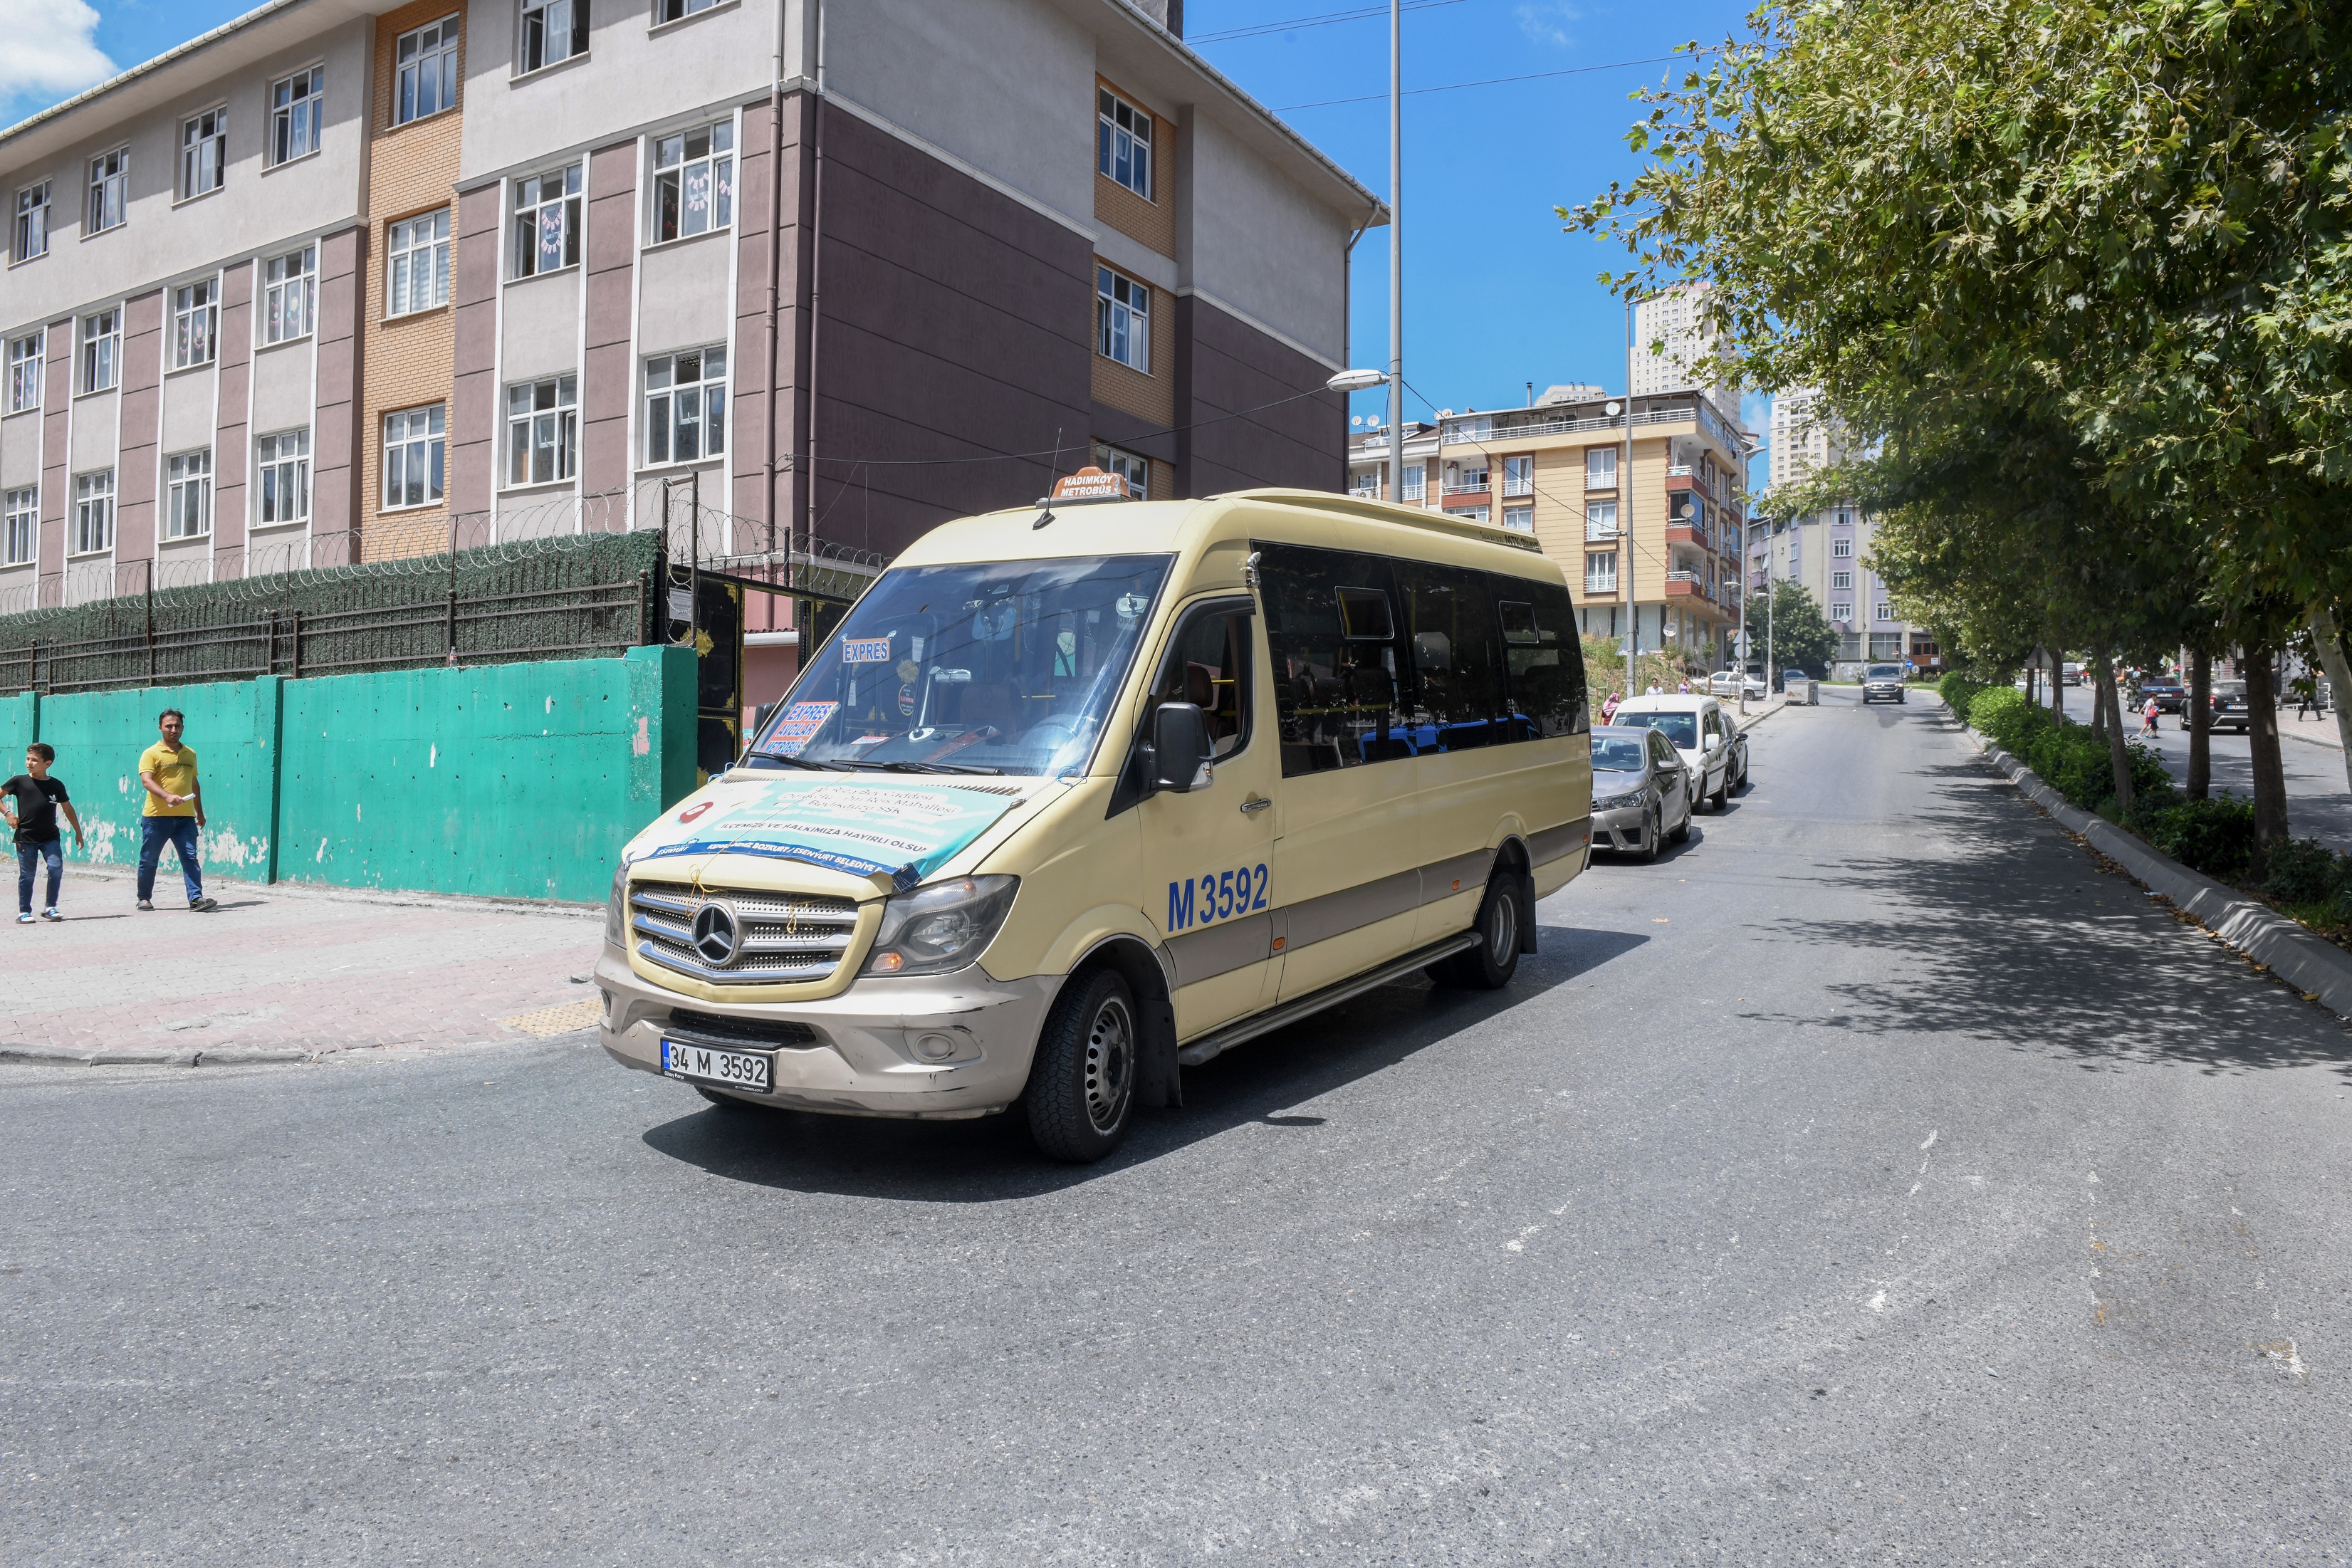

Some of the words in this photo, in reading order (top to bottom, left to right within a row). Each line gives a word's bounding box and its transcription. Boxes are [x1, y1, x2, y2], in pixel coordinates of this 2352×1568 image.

[1065, 474, 1113, 486] HADIMKÖY
[1060, 484, 1112, 497] METROBÜS
[1505, 535, 1522, 546] MTK
[845, 642, 888, 662] EXPRES
[788, 705, 832, 721] EXPRES
[776, 723, 816, 736] AVCILAR
[765, 738, 804, 753] METROBÜS
[894, 800, 957, 814] Mahallesi
[783, 823, 841, 837] HALKIMIZA
[843, 830, 889, 845] HAYIRLI
[752, 843, 790, 854] BOZKURT
[793, 847, 835, 861] ESENYURT
[834, 857, 876, 872] BELEDİYE
[1168, 878, 1194, 932] M
[1199, 863, 1268, 924] 3592
[670, 1046, 689, 1071] 34
[697, 1050, 711, 1075] M
[720, 1054, 765, 1084] 3592
